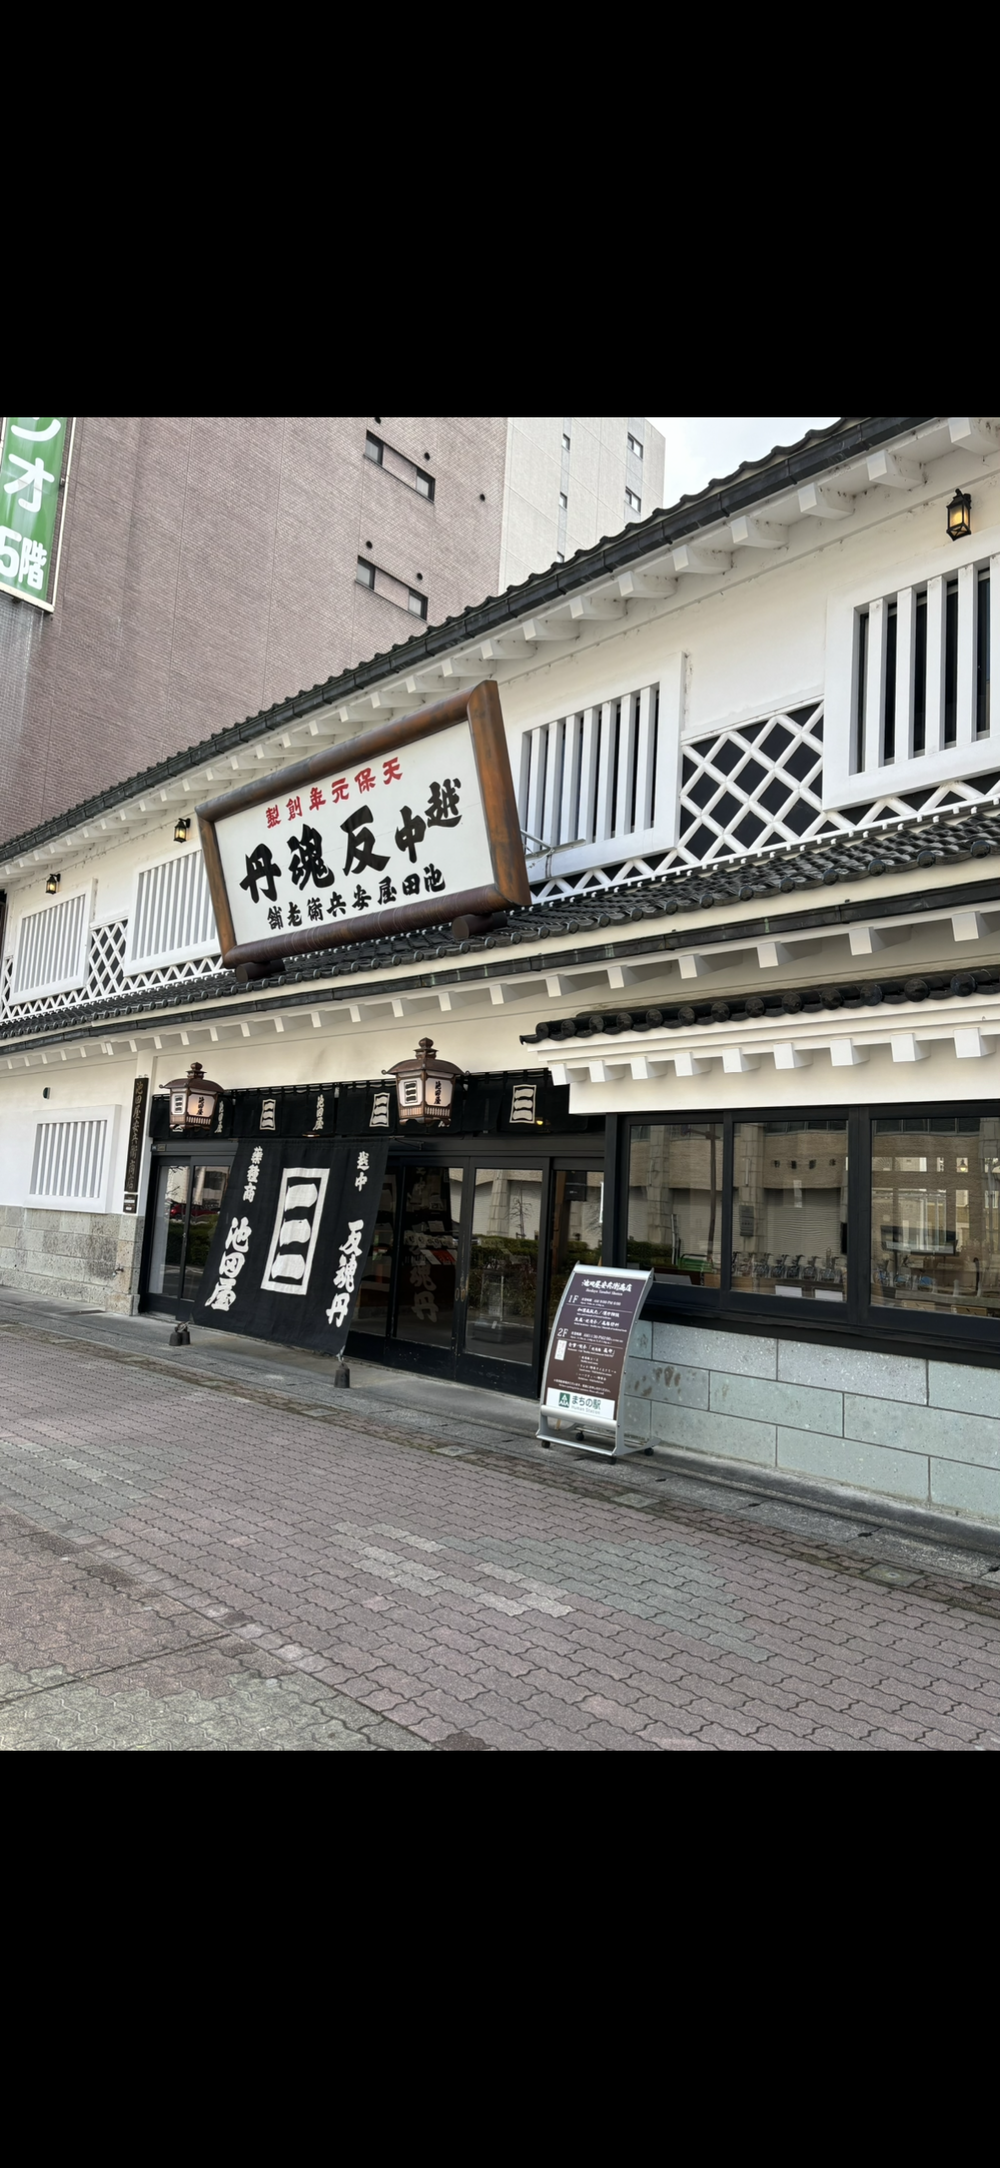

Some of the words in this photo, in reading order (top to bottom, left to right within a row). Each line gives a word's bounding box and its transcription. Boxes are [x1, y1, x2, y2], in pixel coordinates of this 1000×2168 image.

[0, 525, 47, 590] 5階
[205, 1216, 252, 1312] 池田屋
[326, 1219, 364, 1328] 反魂丹
[557, 1328, 568, 1337] 2F
